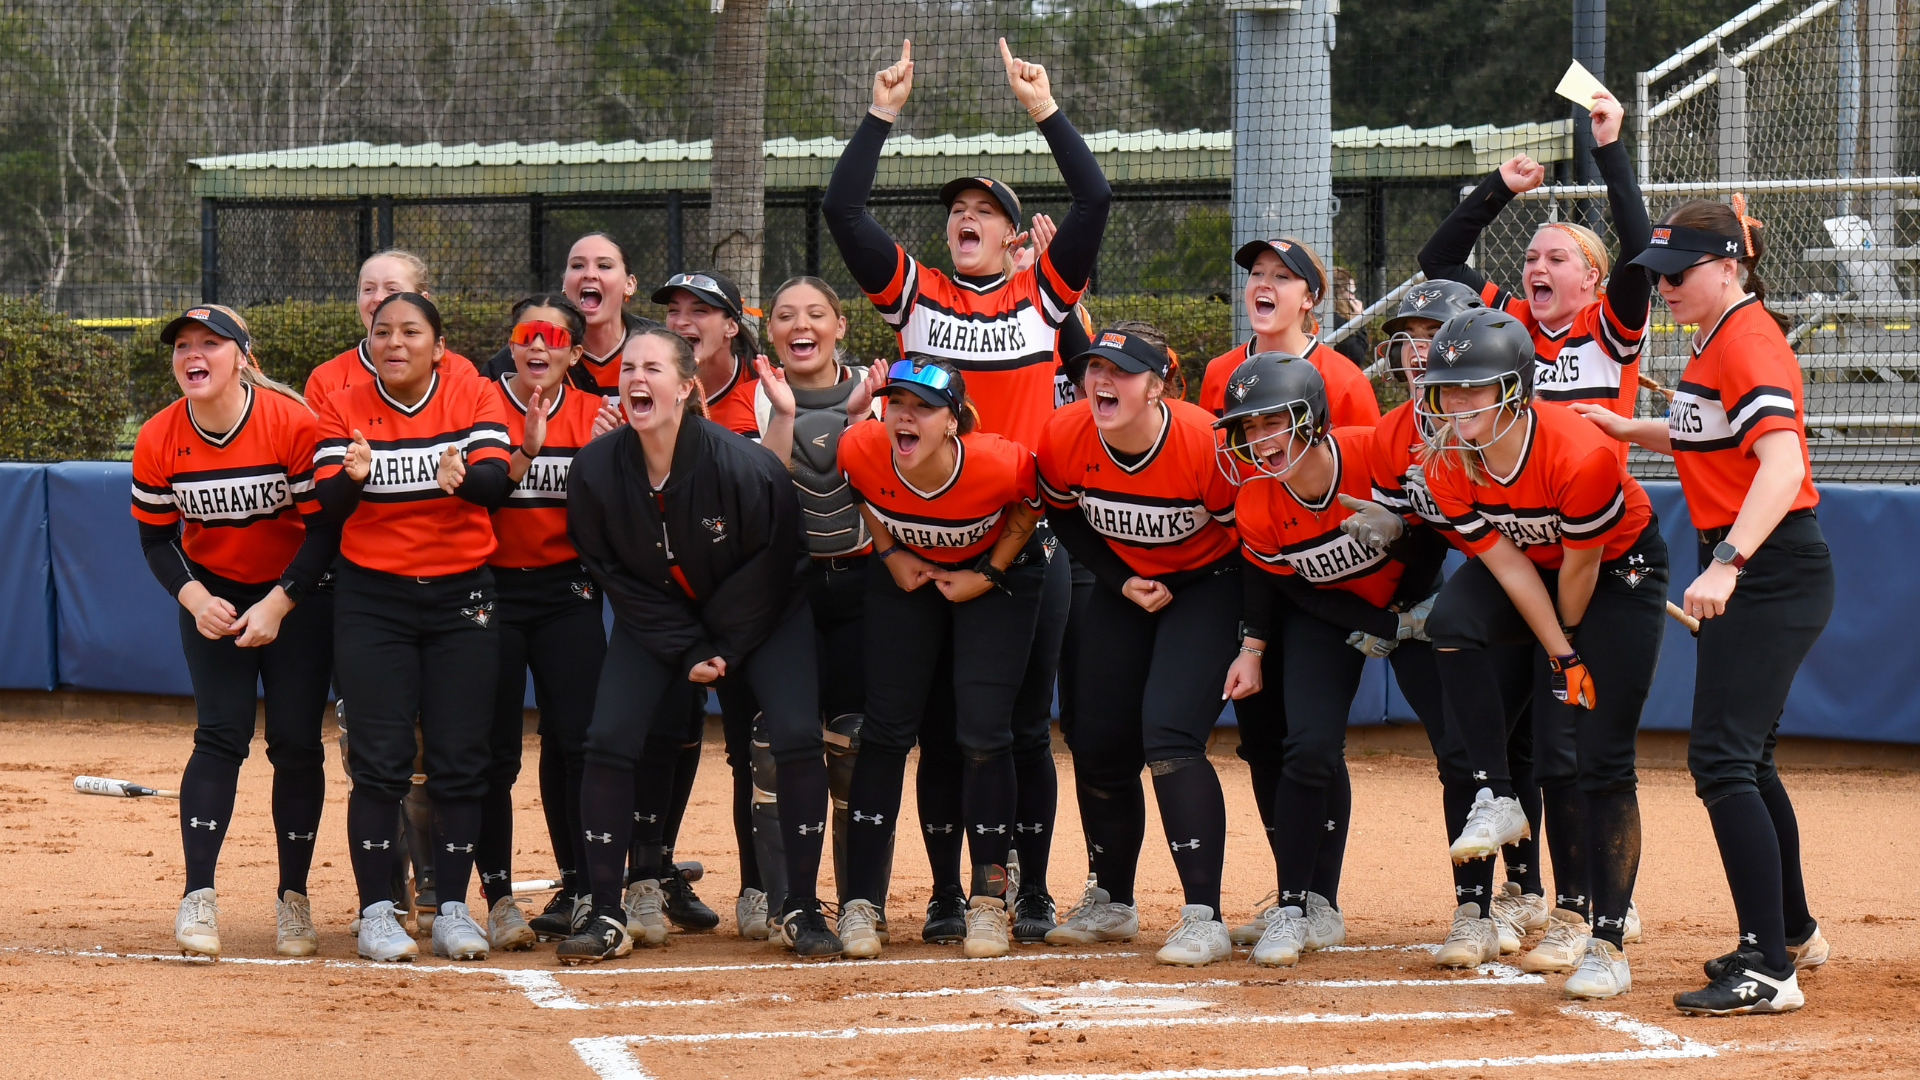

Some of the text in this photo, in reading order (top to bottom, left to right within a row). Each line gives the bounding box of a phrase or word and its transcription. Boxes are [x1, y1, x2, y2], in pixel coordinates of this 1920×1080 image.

[927, 318, 1026, 352] WARHAWKS
[174, 479, 287, 515] WARHAWKS
[1287, 538, 1379, 578] WARHAW
